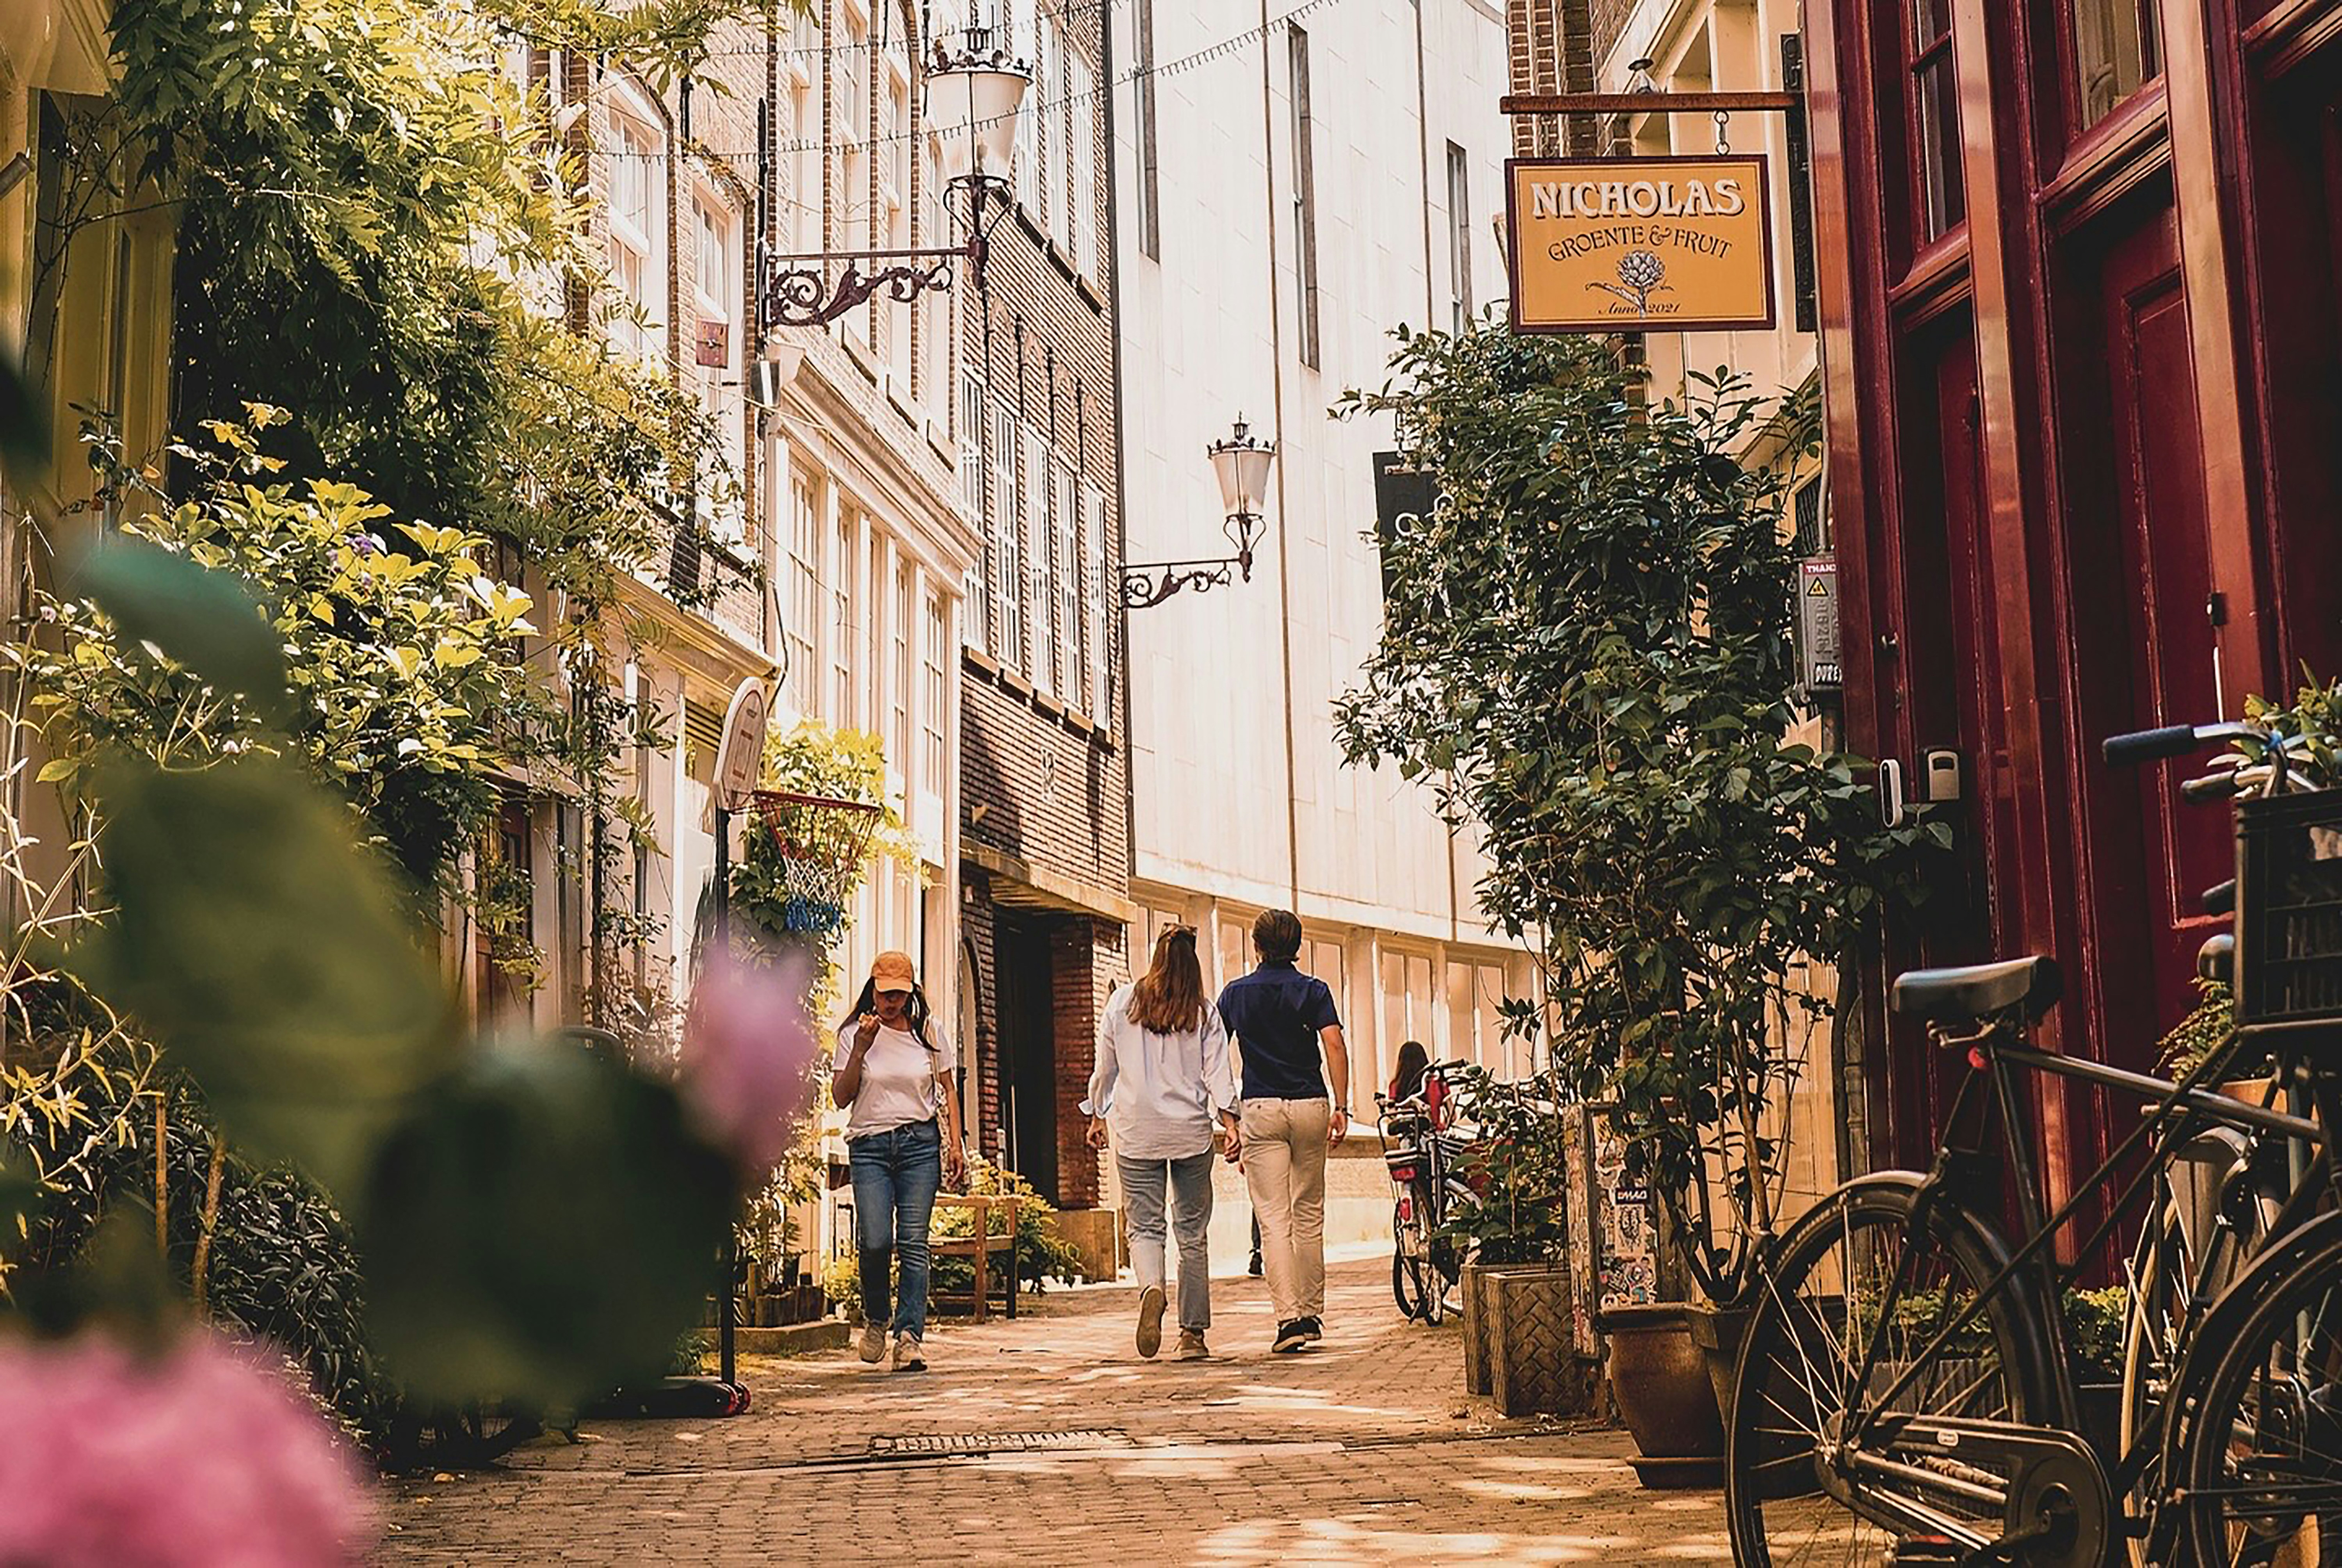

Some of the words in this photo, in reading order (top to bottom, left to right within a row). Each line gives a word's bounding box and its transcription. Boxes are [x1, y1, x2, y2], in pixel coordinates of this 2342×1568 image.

[1531, 178, 1746, 220] NICHOLAS
[1548, 226, 1644, 261] GROENTE
[1649, 225, 1671, 246] &
[1673, 228, 1733, 259] FRUIT
[1598, 302, 1639, 315] Anno
[1648, 303, 1680, 314] 2021
